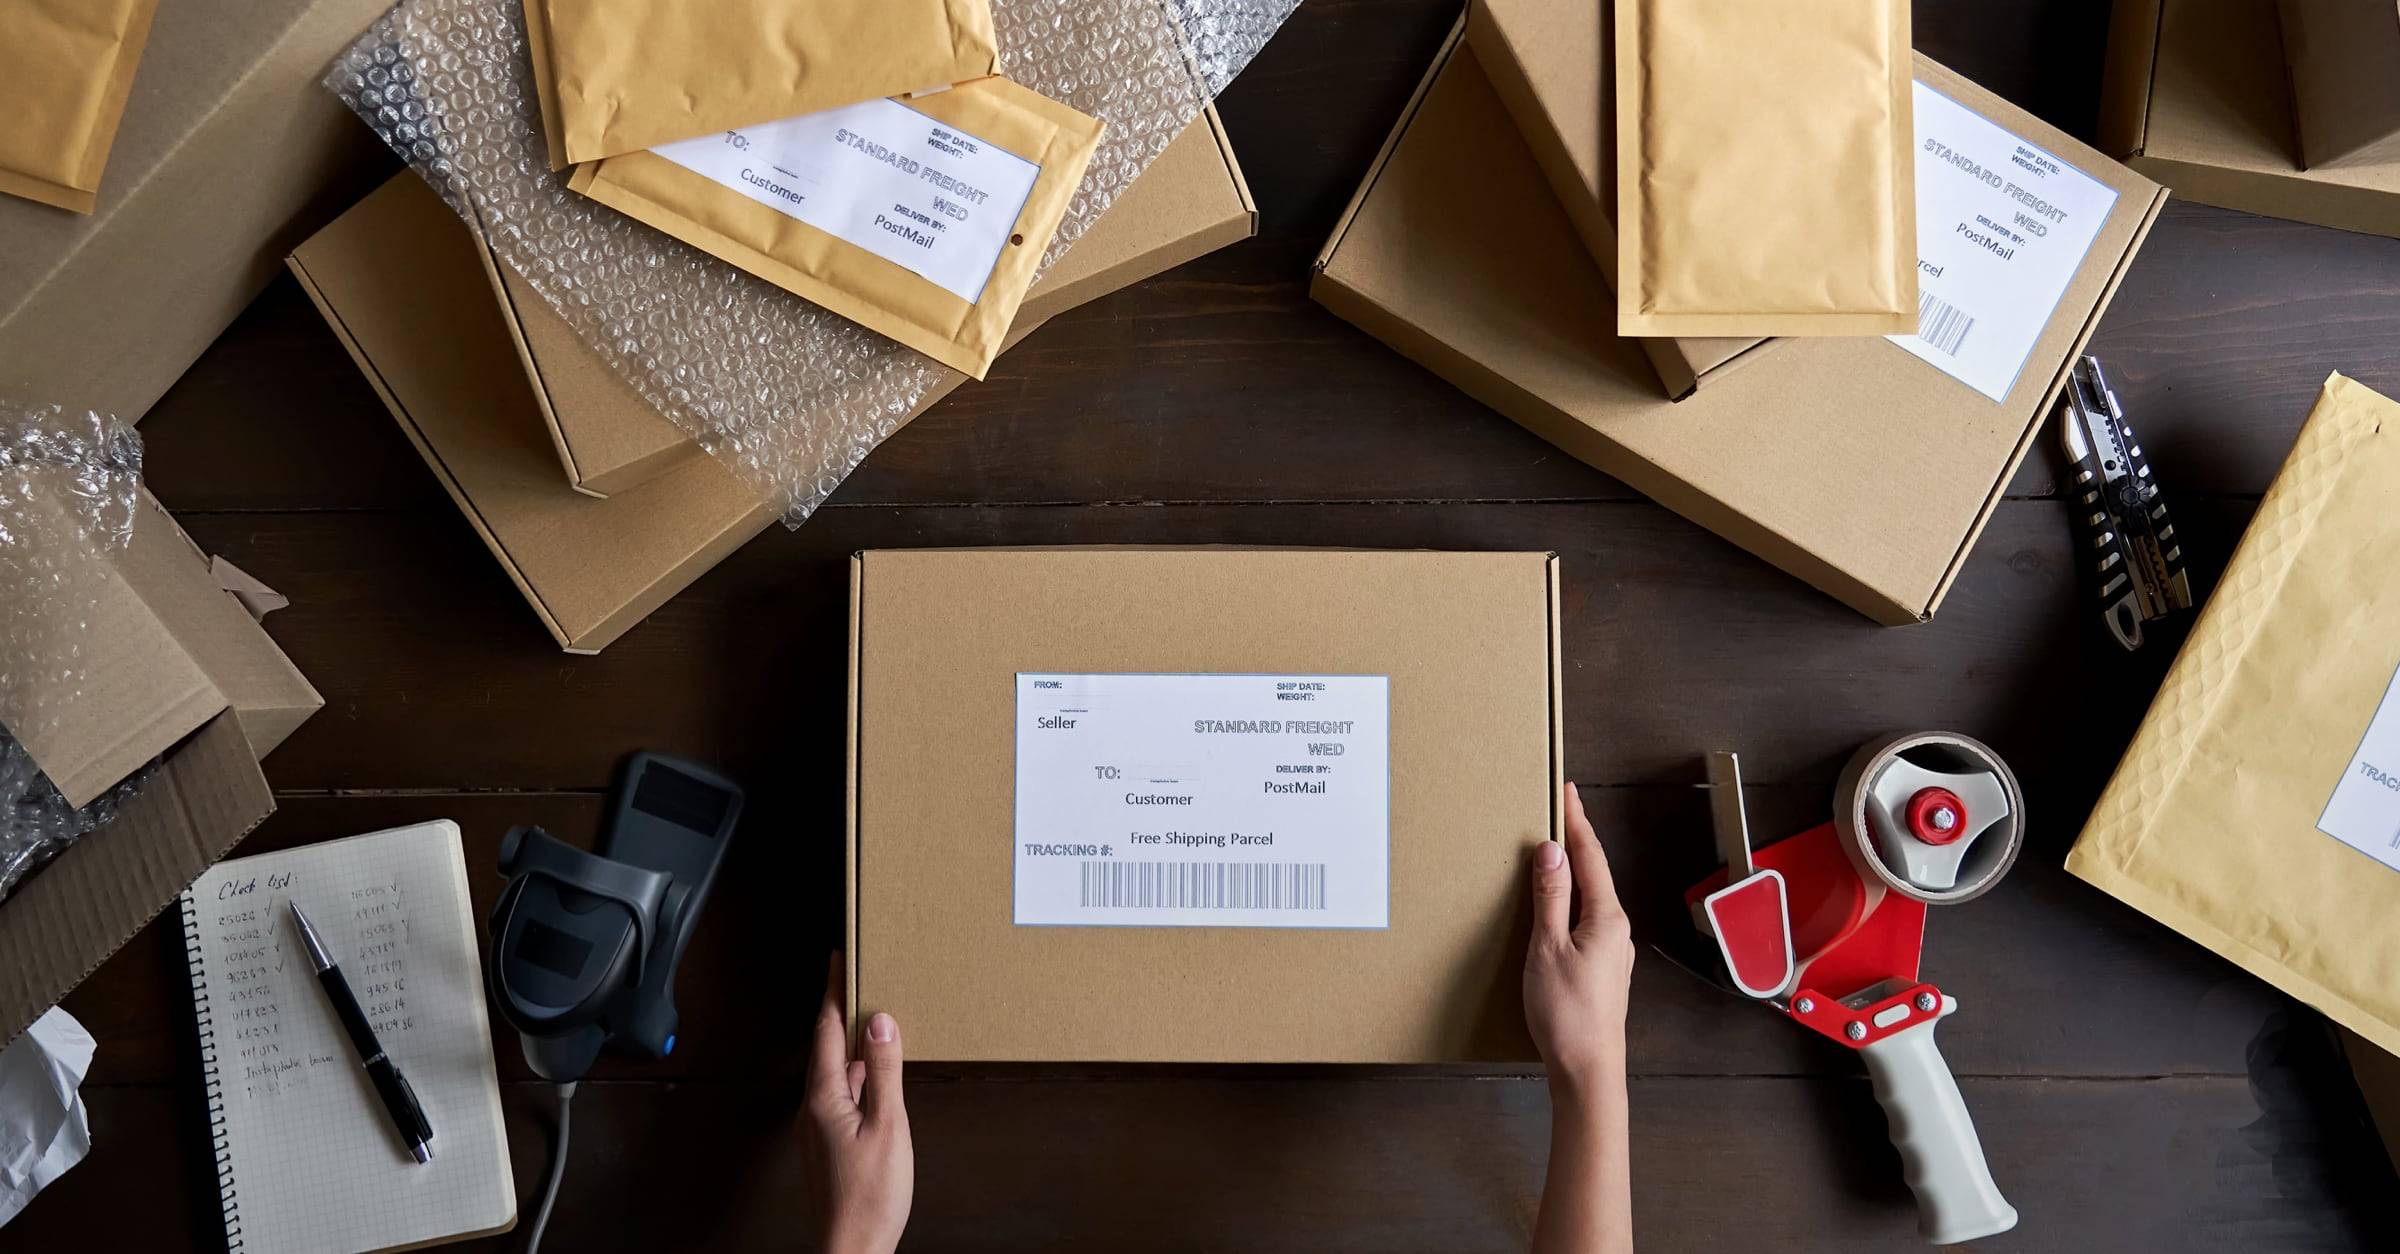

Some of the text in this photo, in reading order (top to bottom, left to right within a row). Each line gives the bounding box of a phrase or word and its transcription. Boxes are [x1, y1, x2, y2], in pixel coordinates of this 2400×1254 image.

[726, 131, 749, 150] TO:
[928, 138, 964, 159] WEIGHT:
[932, 128, 978, 154] SHIP DATE:
[835, 129, 989, 206] STANDARD FREIGHT
[2036, 156, 2060, 176] DATE:
[742, 169, 804, 204] Customer
[1924, 138, 2068, 224] STANDARD FREIGHT
[933, 196, 969, 221] WED
[894, 204, 947, 233] DELIVER BY:
[2014, 211, 2048, 238] WED
[874, 214, 936, 250] PostMail
[1976, 214, 2026, 247] DELIVER BY:
[1956, 222, 2014, 261] PostMail
[1034, 680, 1063, 690] FROM:
[1276, 682, 1326, 691] SHIP DATE:
[1276, 692, 1315, 702] WEIGHT:
[1037, 716, 1077, 731] Seller
[1193, 720, 1354, 735] STANDARD FREIGHT
[1307, 742, 1345, 756] WED
[1094, 766, 1121, 780] TO:
[1276, 765, 1332, 774] DELIVER BY:
[1263, 780, 1327, 795] PostMail
[1124, 792, 1194, 806] Customer
[1130, 831, 1274, 848] Free Shipping Parcel
[1025, 843, 1098, 857] TRACKING
[218, 877, 256, 901] Check
